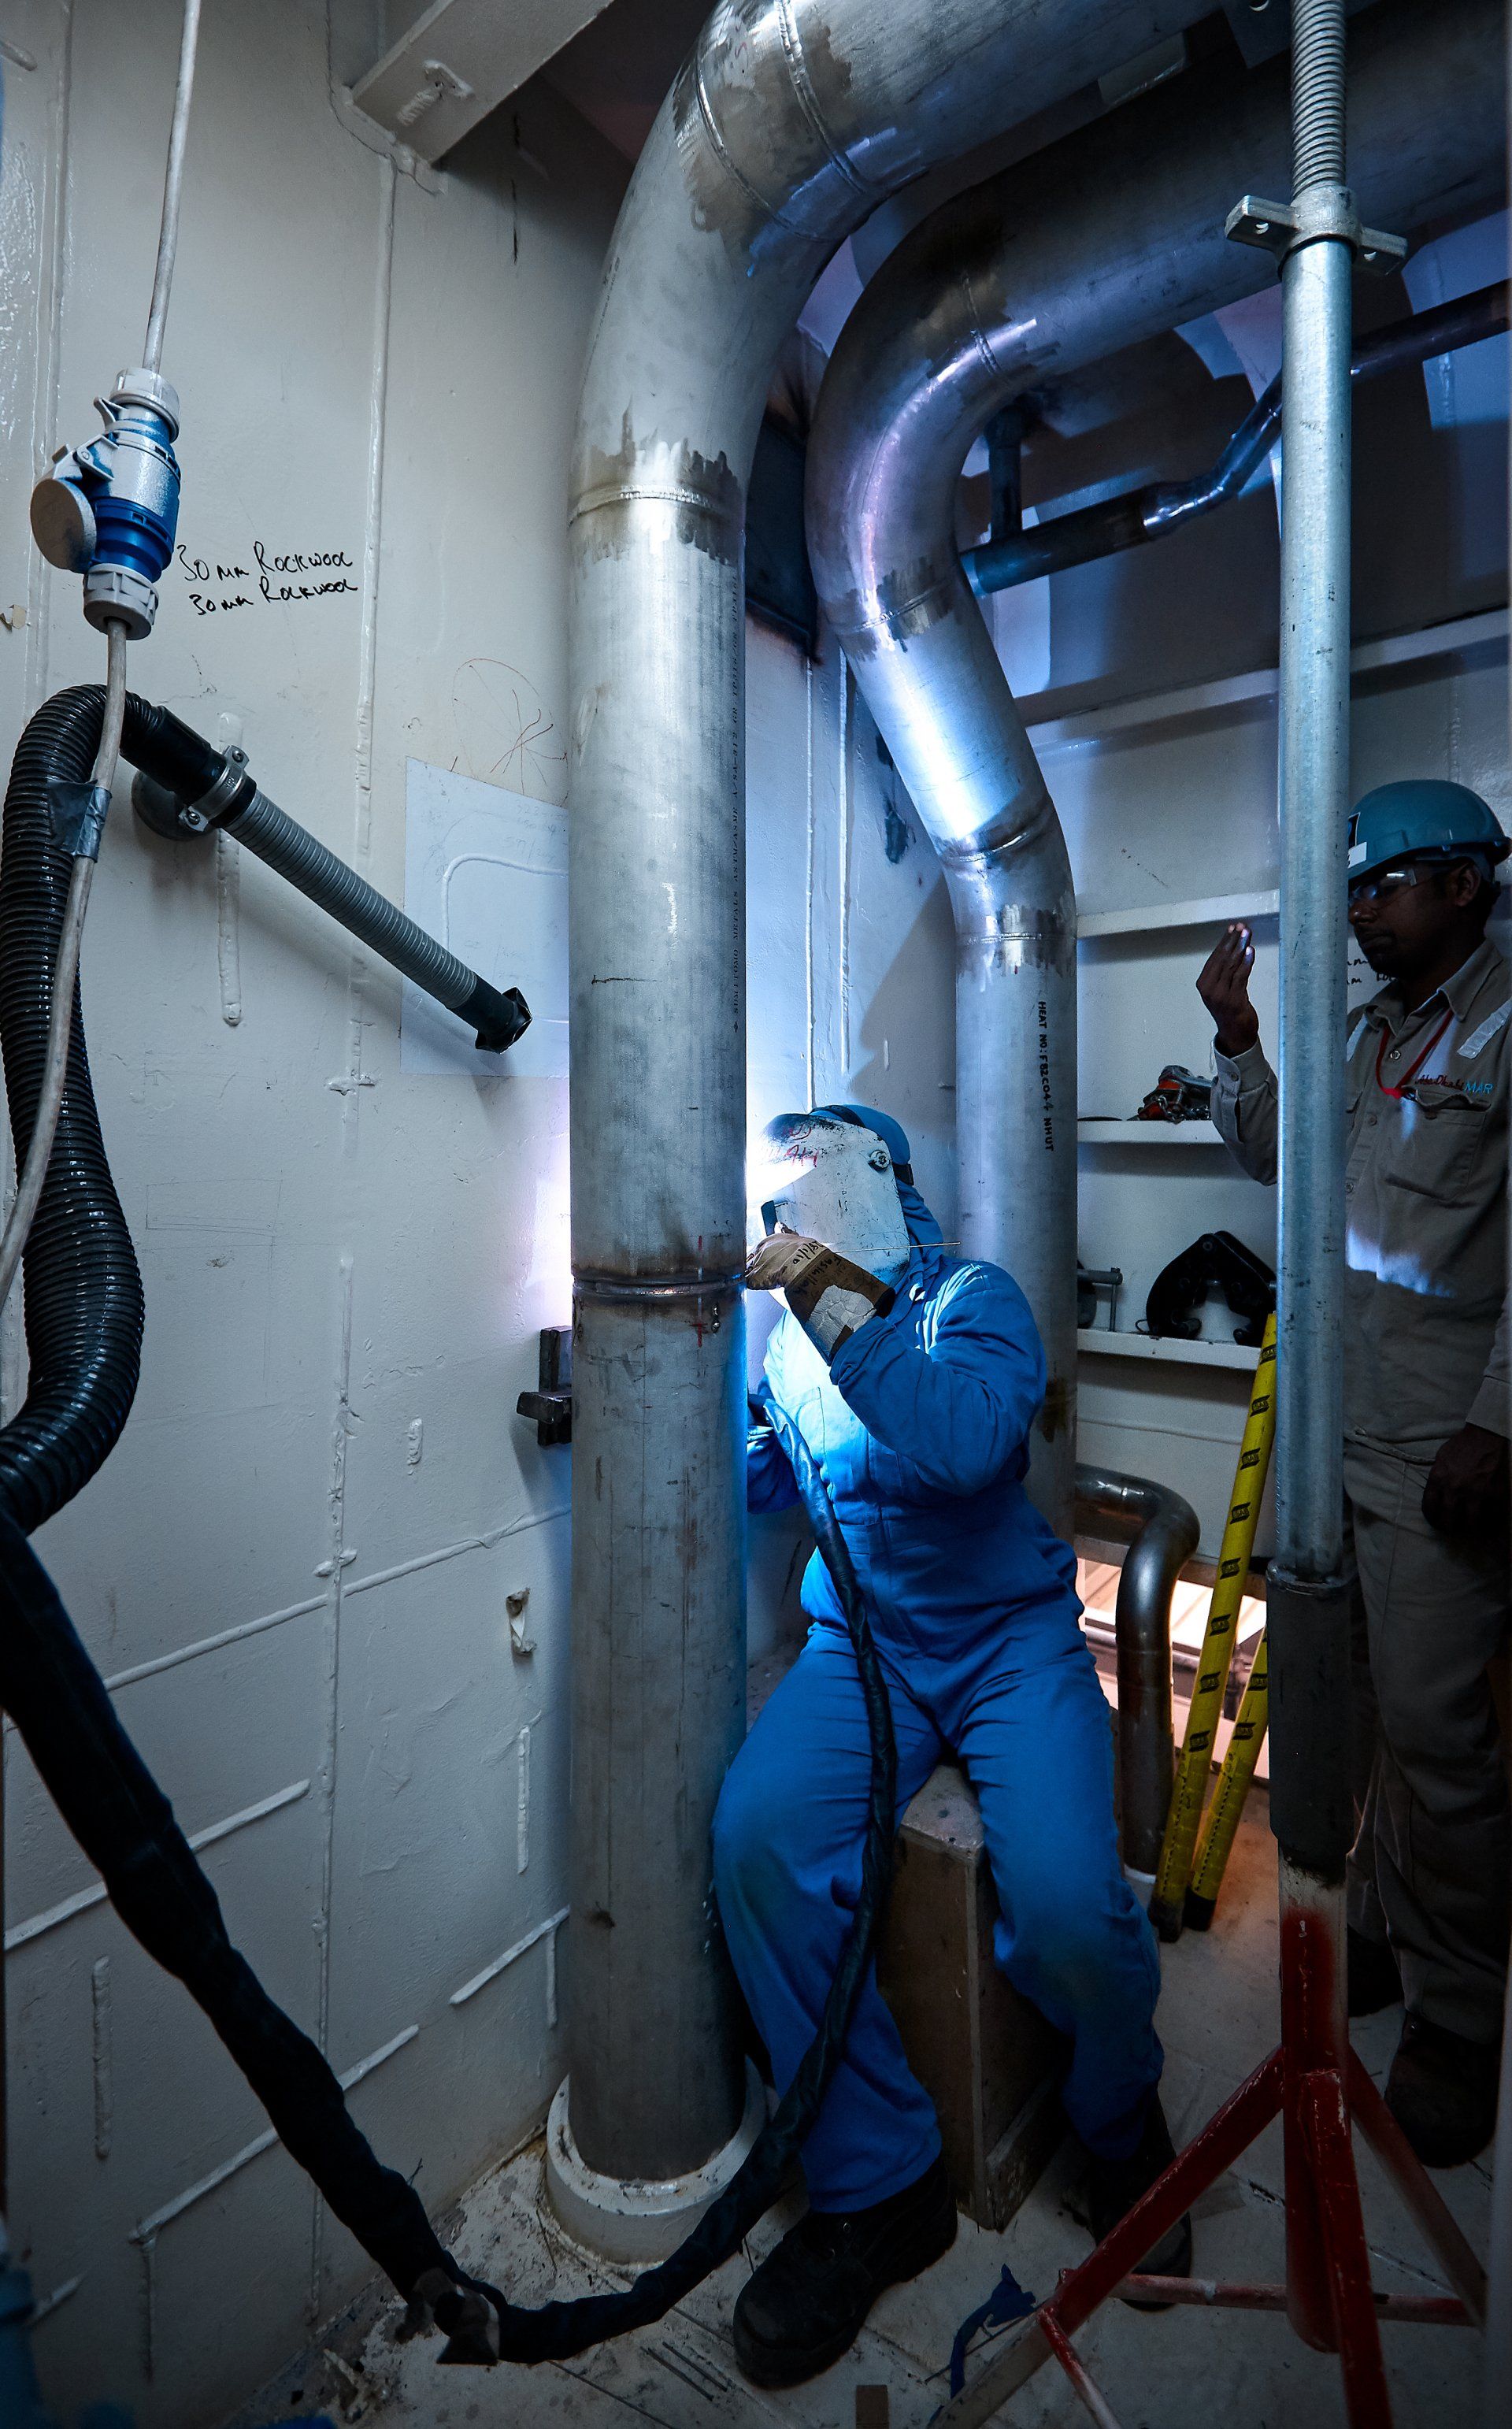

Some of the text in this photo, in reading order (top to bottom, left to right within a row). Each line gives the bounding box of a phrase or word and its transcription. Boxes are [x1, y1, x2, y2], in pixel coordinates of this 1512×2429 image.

[1038, 1001, 1047, 1029] HEAT
[1043, 1117, 1054, 1152] NHUT
[1464, 1081, 1495, 1095] MAR
